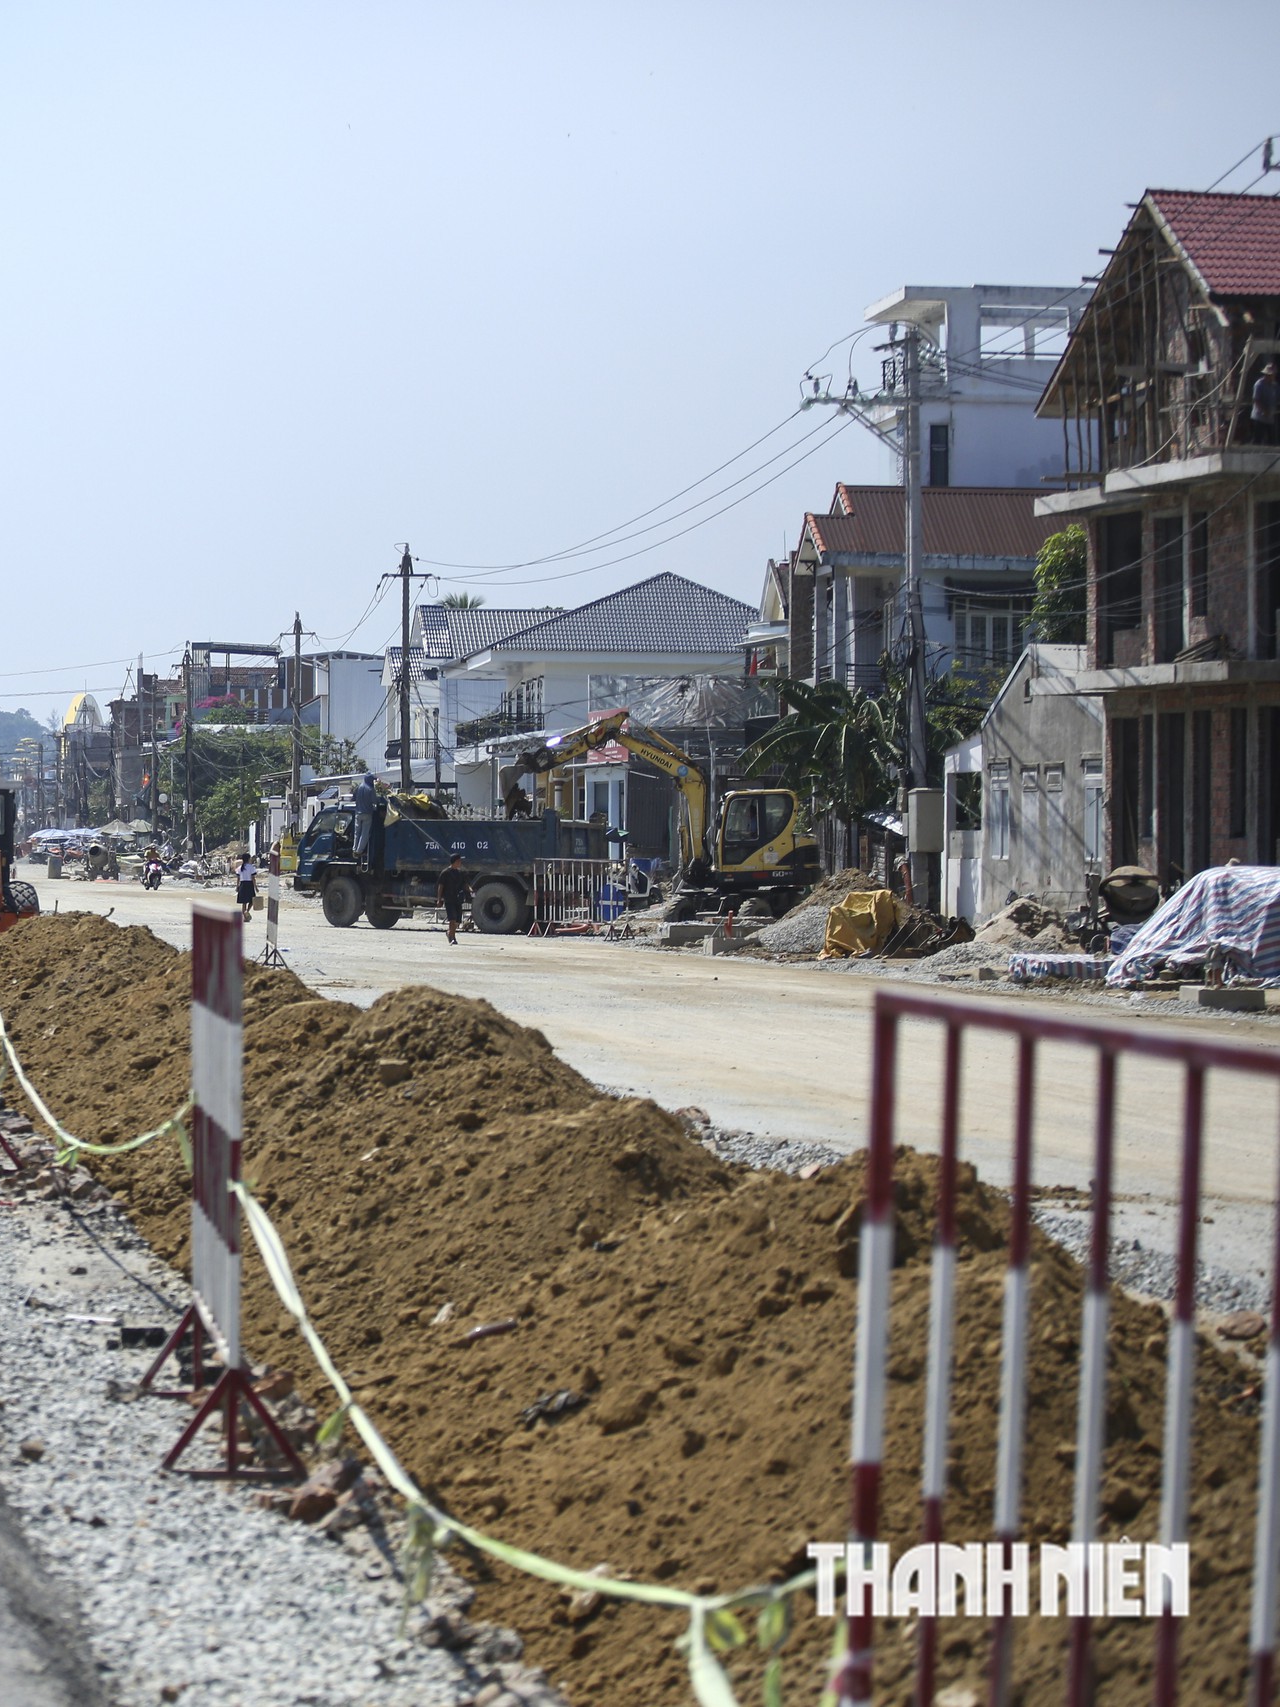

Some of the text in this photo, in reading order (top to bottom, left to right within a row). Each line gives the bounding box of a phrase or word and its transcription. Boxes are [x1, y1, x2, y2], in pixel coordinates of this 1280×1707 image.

[640, 748, 673, 769] HYUNDAI
[425, 841, 489, 850] 75A 410 02
